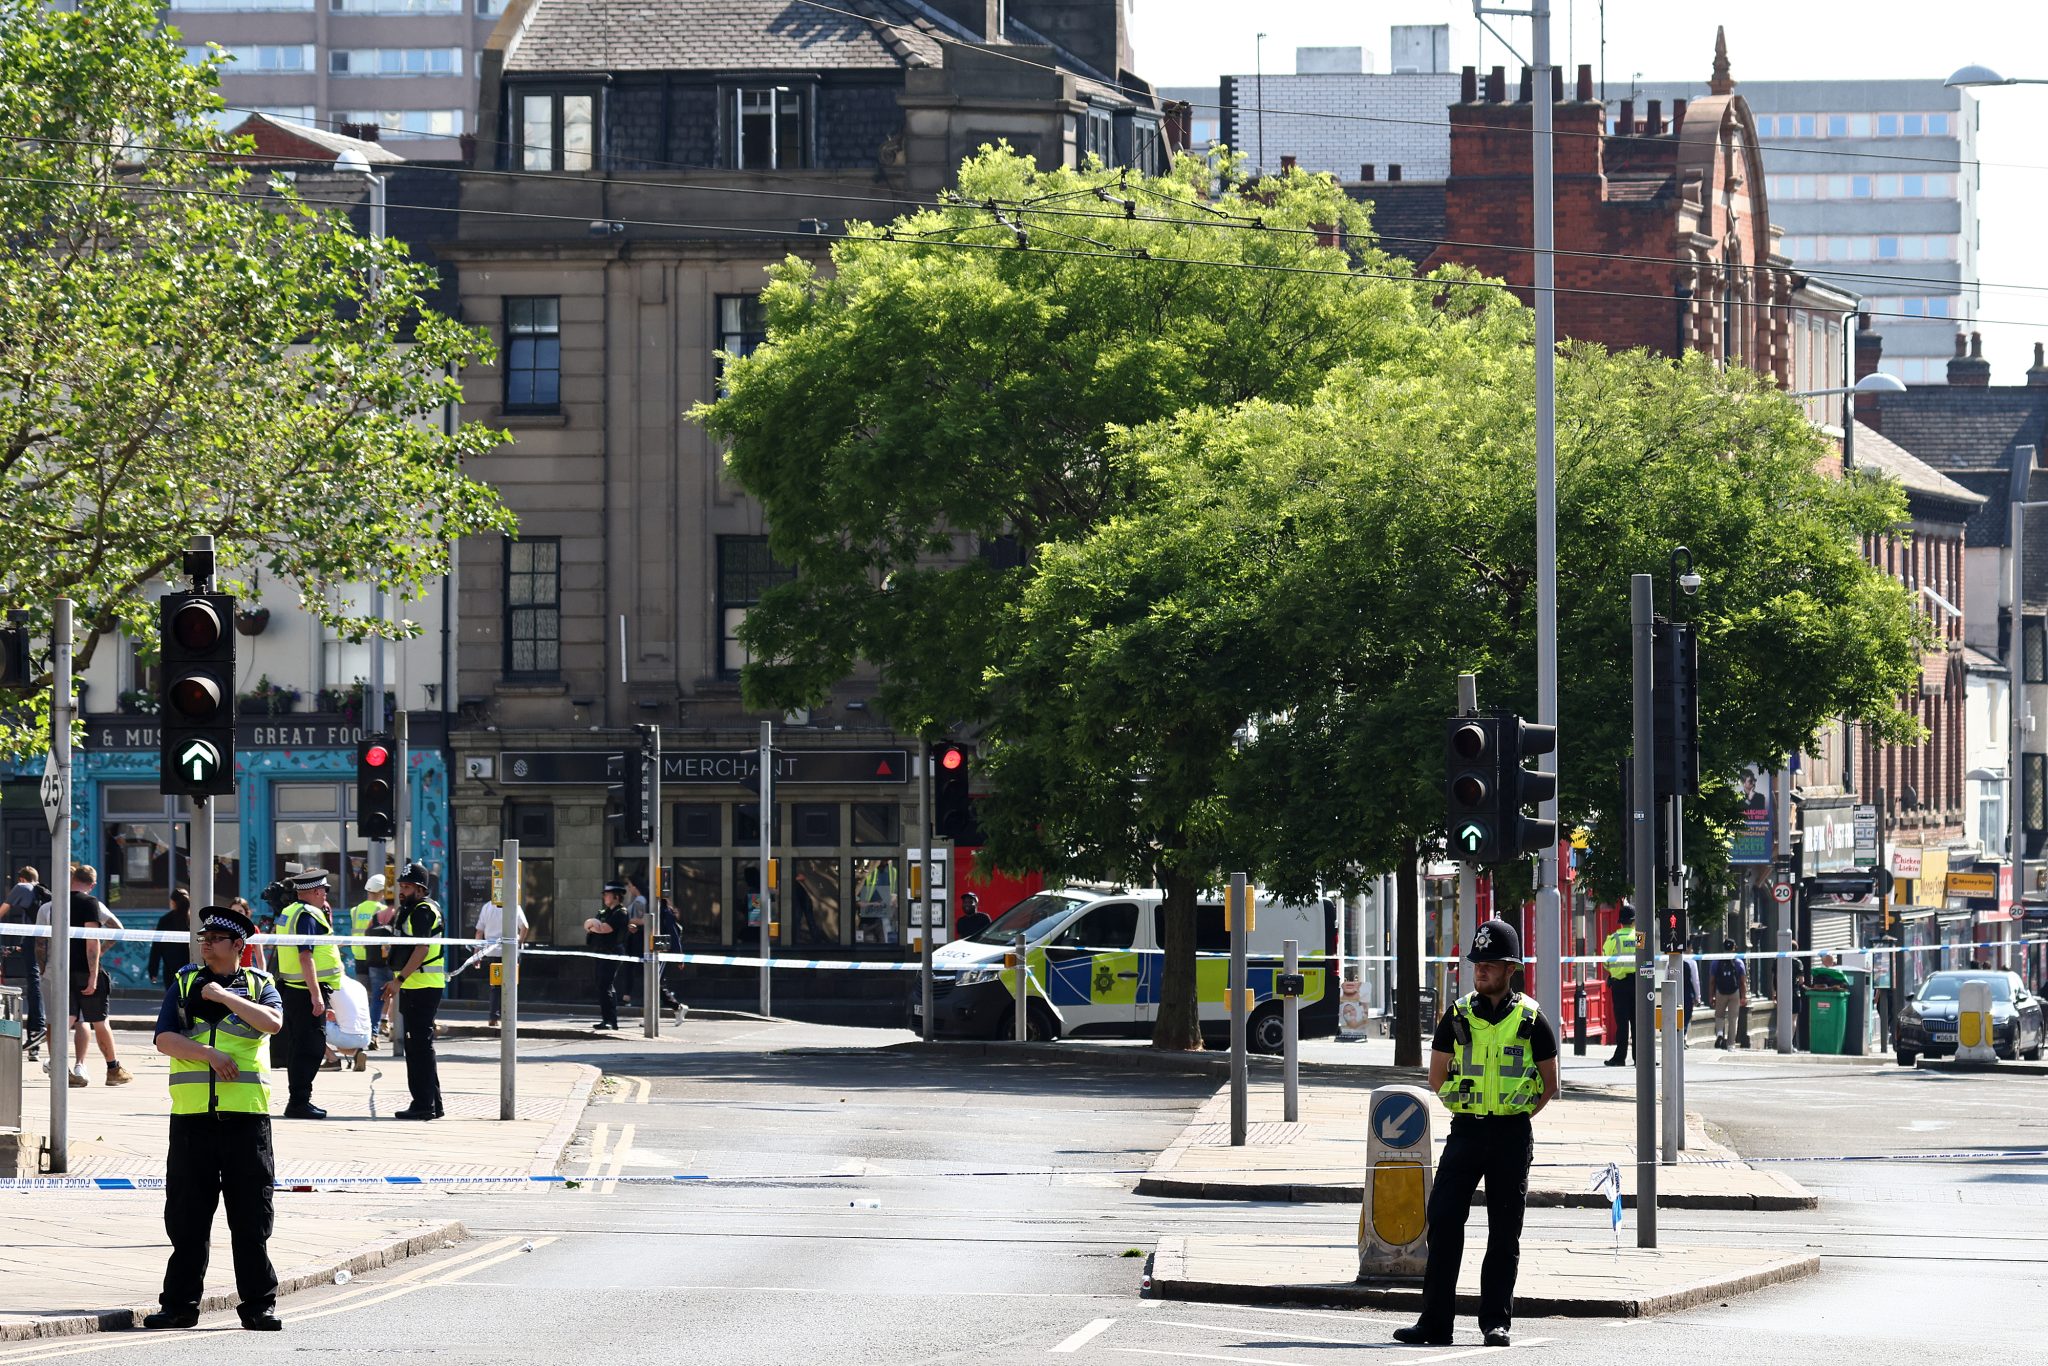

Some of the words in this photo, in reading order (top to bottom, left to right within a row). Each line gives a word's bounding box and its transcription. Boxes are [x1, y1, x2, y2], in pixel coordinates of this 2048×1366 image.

[126, 729, 161, 746] MUS
[254, 727, 316, 744] GREAT
[328, 727, 362, 744] FOO
[44, 774, 60, 808] 25
[1894, 855, 1920, 864] Chicken
[1775, 888, 1790, 897] 20
[0, 1178, 16, 1188] CRO
[17, 1178, 33, 1188] NOT
[34, 1178, 45, 1188] DO
[48, 1178, 63, 1188] LINE
[65, 1178, 91, 1188] POLICE
